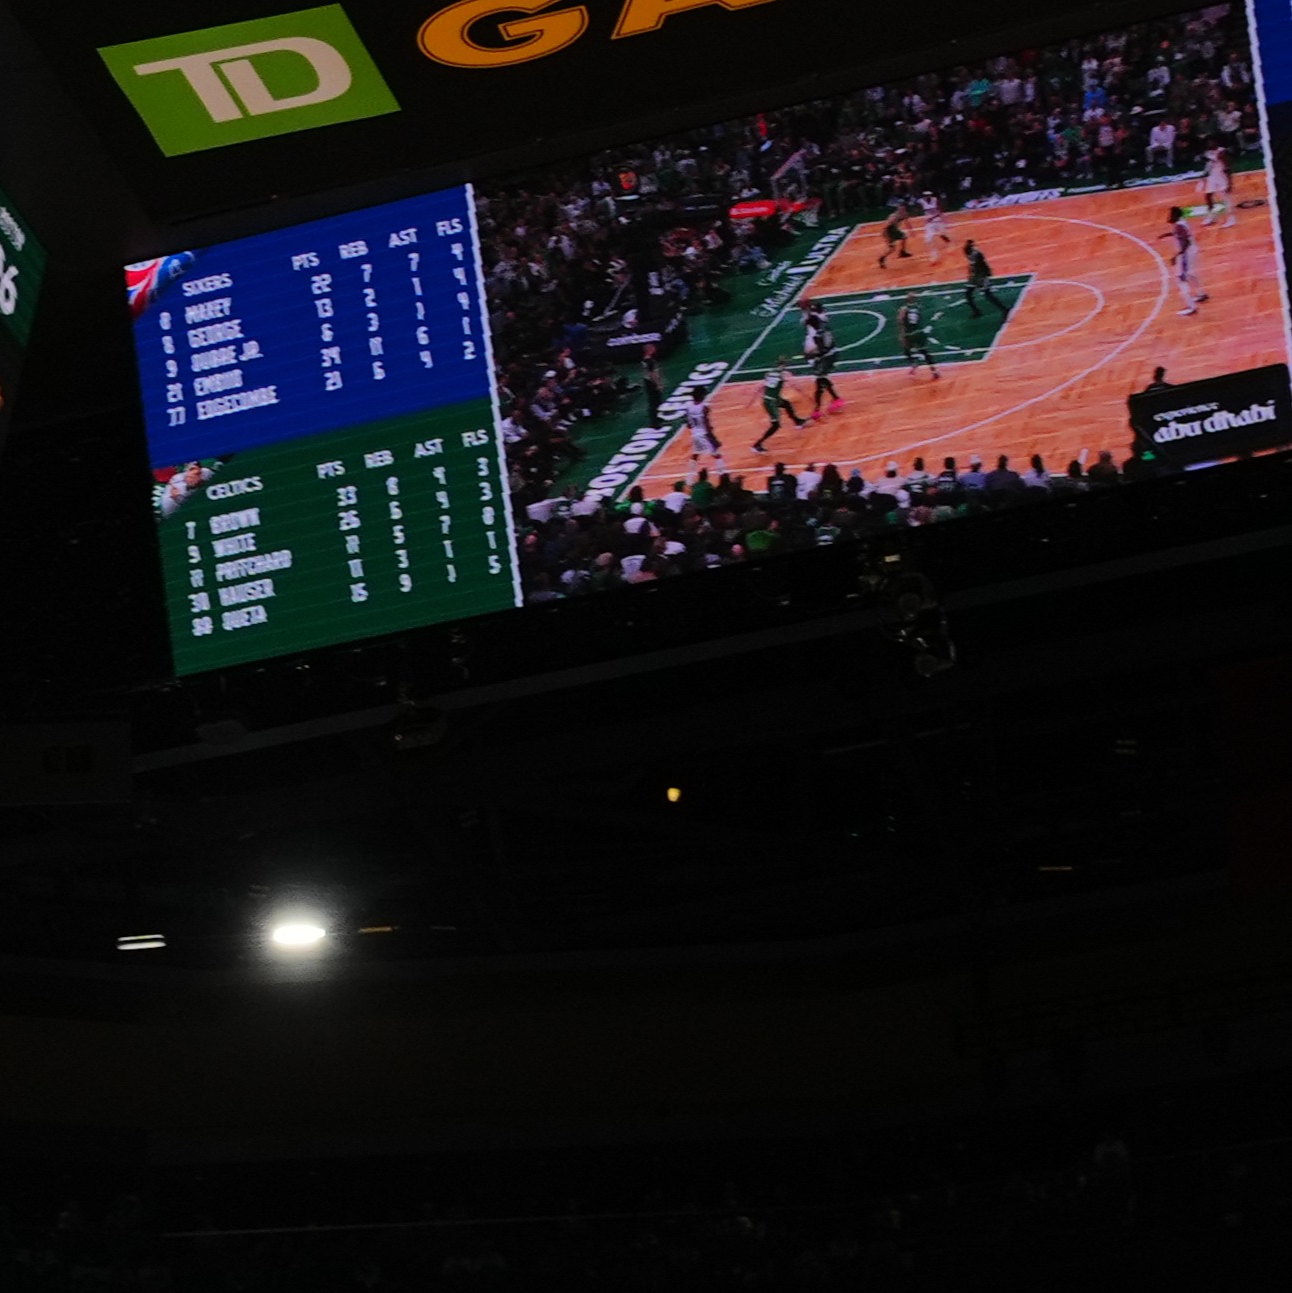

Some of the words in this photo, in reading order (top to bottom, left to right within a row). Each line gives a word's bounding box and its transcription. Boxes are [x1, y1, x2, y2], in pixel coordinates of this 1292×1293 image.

[133, 36, 352, 124] TD
[291, 252, 319, 270] PTS
[388, 228, 417, 248] AST
[437, 218, 463, 237] FLS
[362, 264, 372, 282] 7
[365, 289, 375, 307] 2
[368, 313, 379, 332] 3
[417, 326, 429, 346] 6
[463, 341, 477, 360] 2
[207, 477, 264, 501] CELTICS
[318, 460, 345, 480] PTS
[414, 438, 443, 459] AST
[462, 429, 489, 448] FLS
[478, 458, 489, 475] 3
[481, 483, 492, 500] 3
[397, 550, 409, 568] 3
[490, 555, 501, 574] 5
